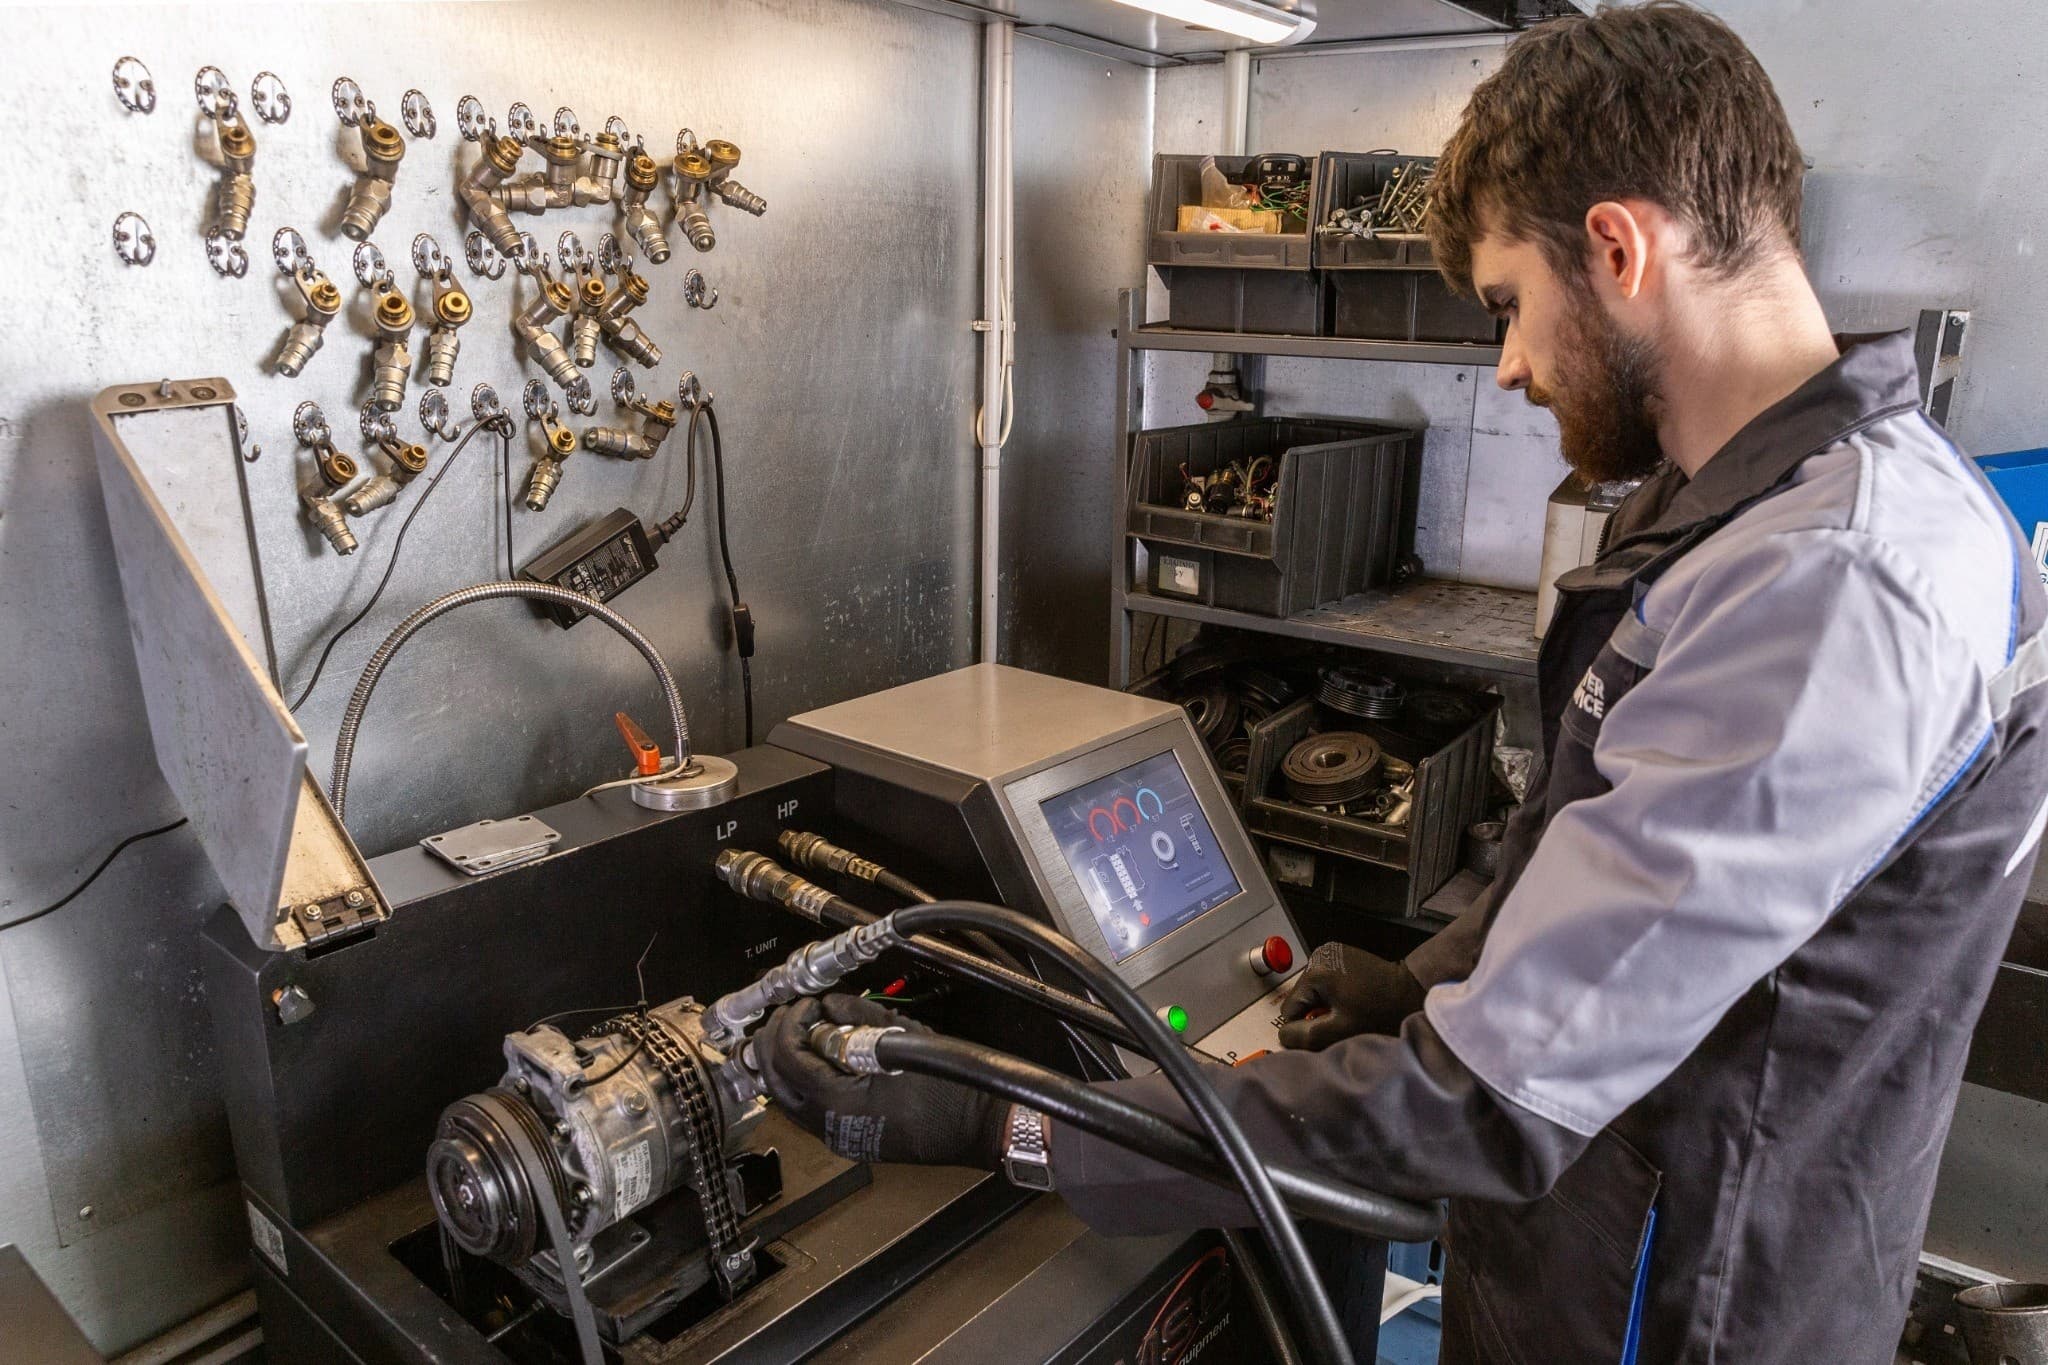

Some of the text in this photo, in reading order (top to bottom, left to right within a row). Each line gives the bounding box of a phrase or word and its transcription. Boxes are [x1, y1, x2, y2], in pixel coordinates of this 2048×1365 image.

[777, 799, 799, 820] HP
[716, 820, 738, 841] LP
[755, 936, 778, 955] UNIT
